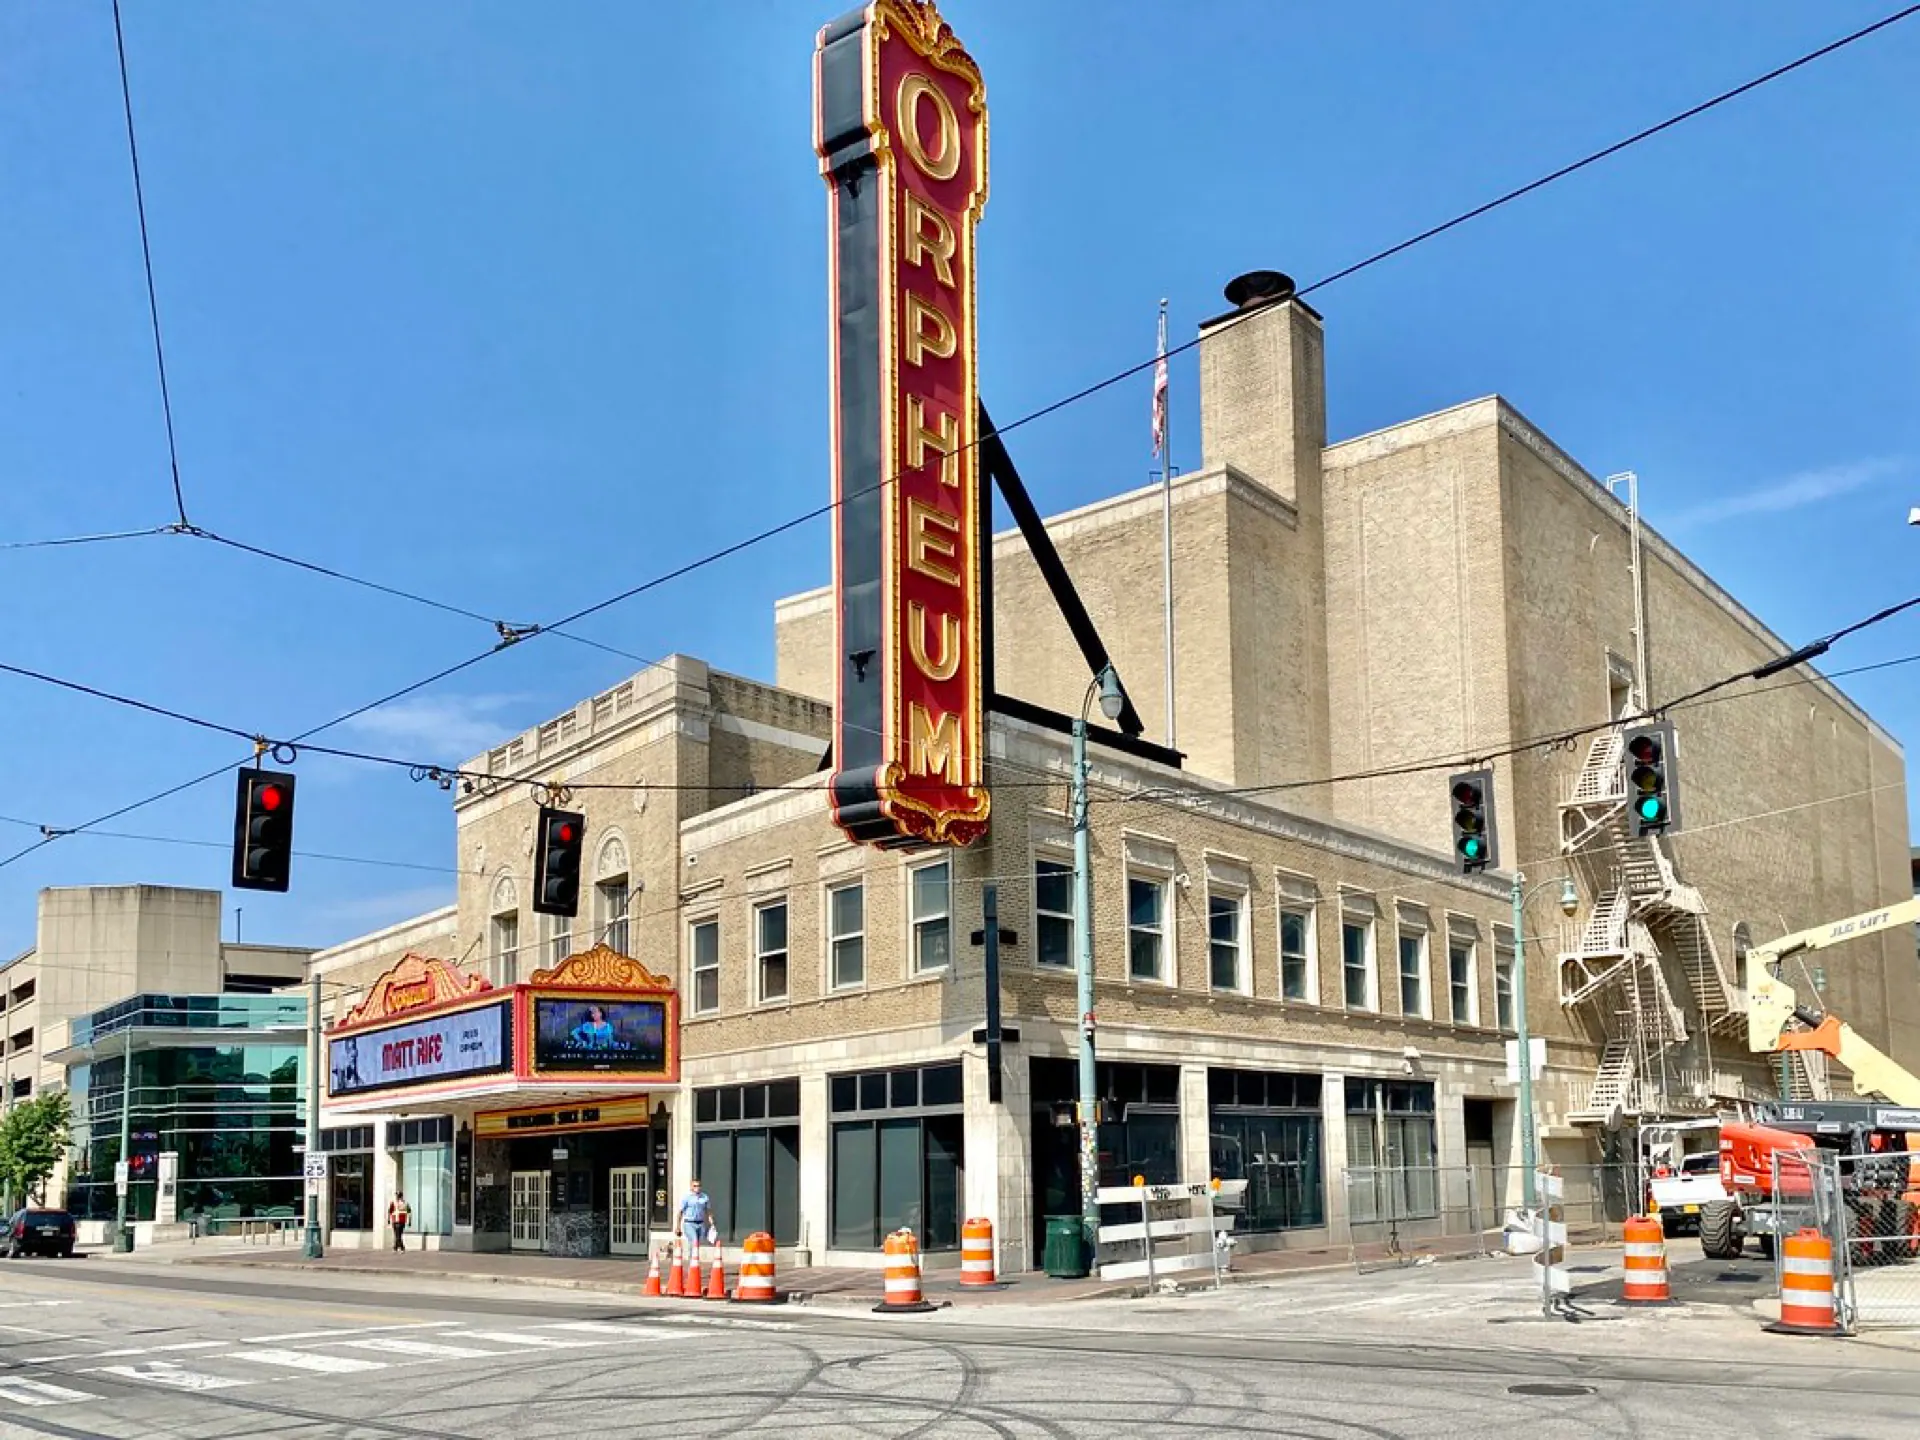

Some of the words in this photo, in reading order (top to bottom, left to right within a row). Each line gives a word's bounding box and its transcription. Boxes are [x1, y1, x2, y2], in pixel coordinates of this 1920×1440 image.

[897, 71, 962, 787] ORPHEUM
[1859, 912, 1890, 929] LIFT
[382, 1039, 415, 1072] MATT
[417, 1032, 444, 1066] RIFE
[306, 1165, 325, 1177] 25
